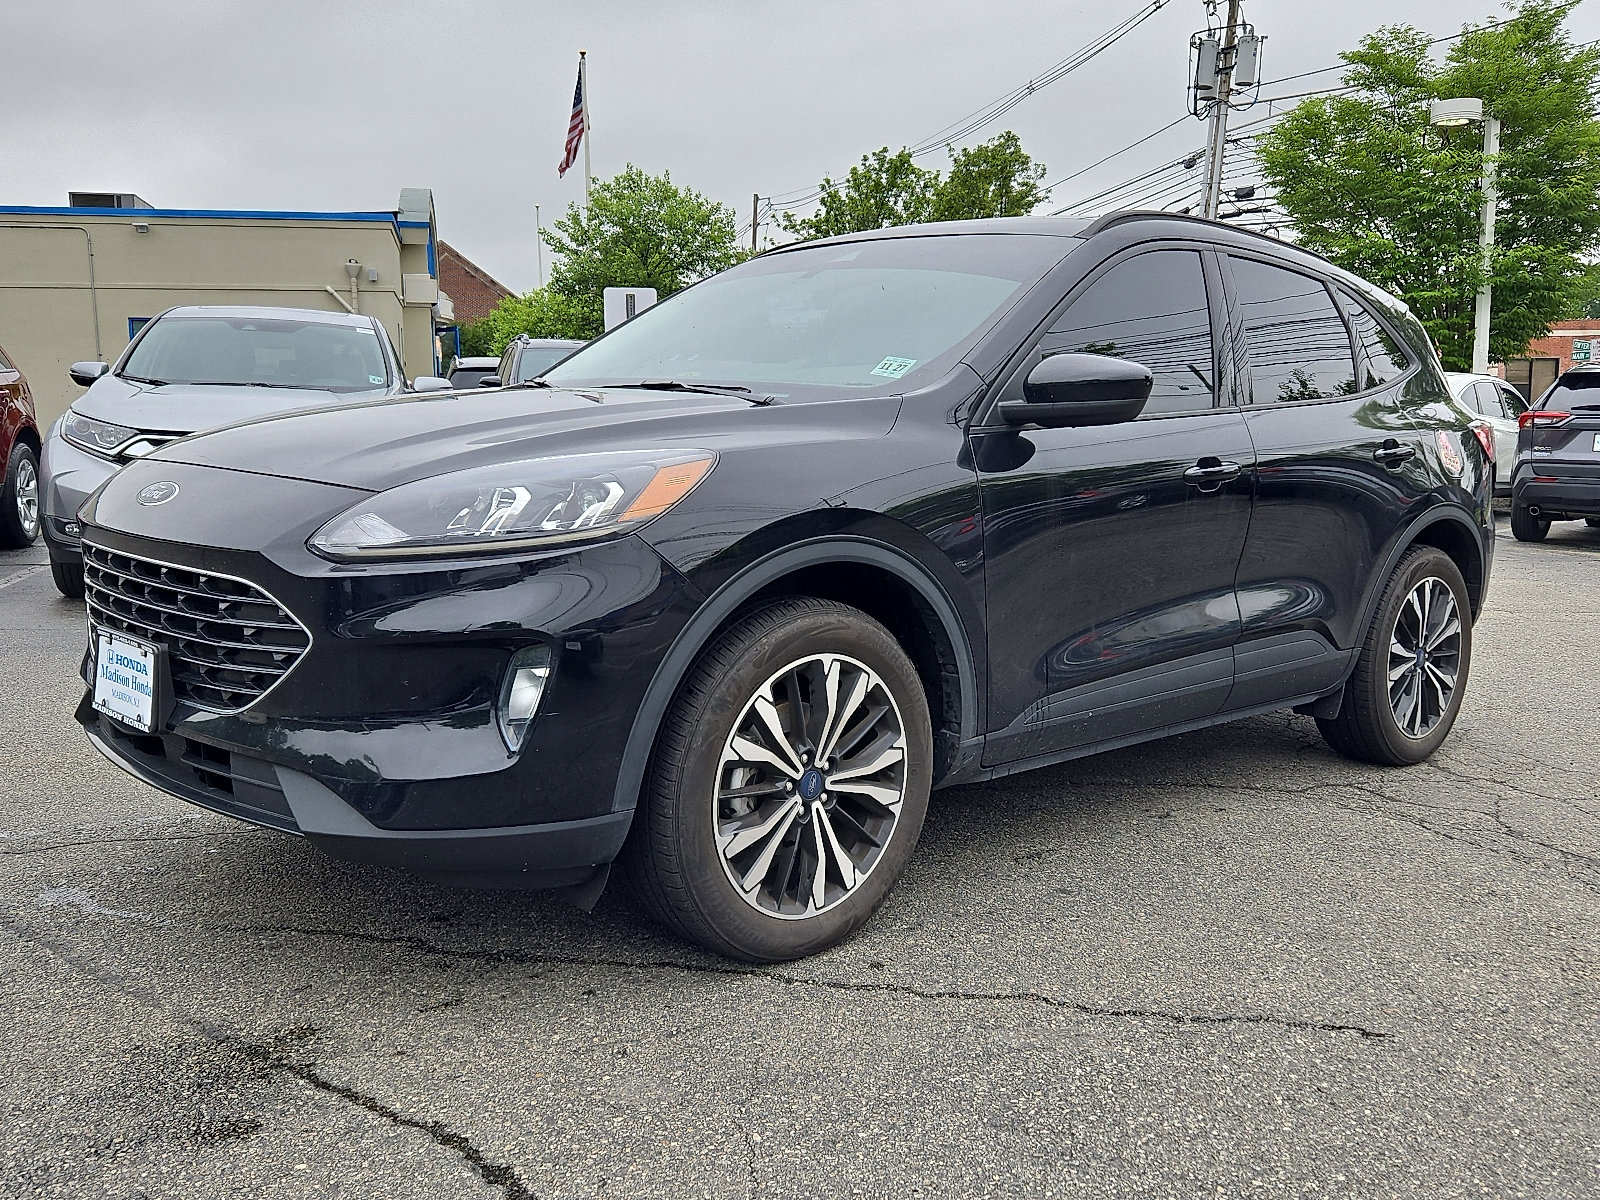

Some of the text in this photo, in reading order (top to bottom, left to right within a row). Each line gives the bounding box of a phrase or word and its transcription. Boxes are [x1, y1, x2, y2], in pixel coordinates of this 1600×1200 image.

[879, 362, 893, 370] 11
[141, 484, 168, 499] Ford
[115, 653, 148, 676] HONDA
[100, 664, 152, 697] Madison Honda
[91, 701, 150, 733] MADISON HONDA
